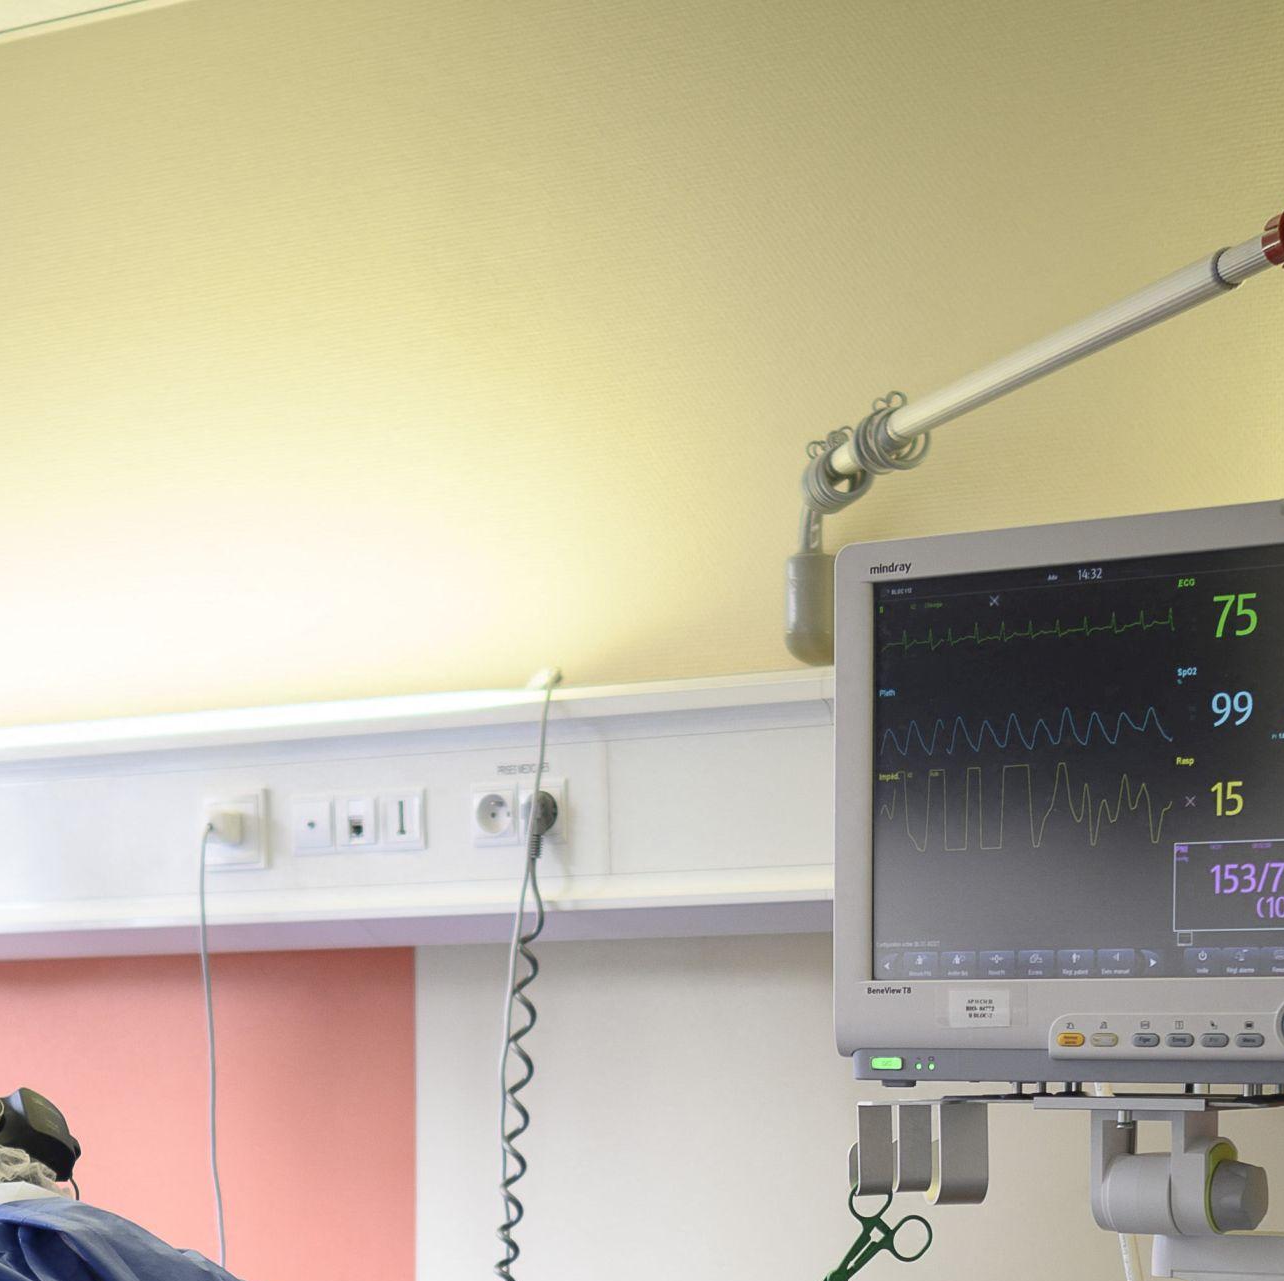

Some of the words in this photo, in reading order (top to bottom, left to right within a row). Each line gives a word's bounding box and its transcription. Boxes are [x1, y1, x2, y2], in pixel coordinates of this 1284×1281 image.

[870, 562, 912, 574] mindray
[1078, 568, 1103, 580] 14:32
[1177, 579, 1196, 588] ECG
[1213, 593, 1258, 638] 75
[1177, 667, 1198, 678] SpO2
[1211, 691, 1253, 727] 99
[1176, 756, 1195, 767] Resp
[1211, 780, 1244, 816] 15
[867, 987, 901, 995] BeneView
